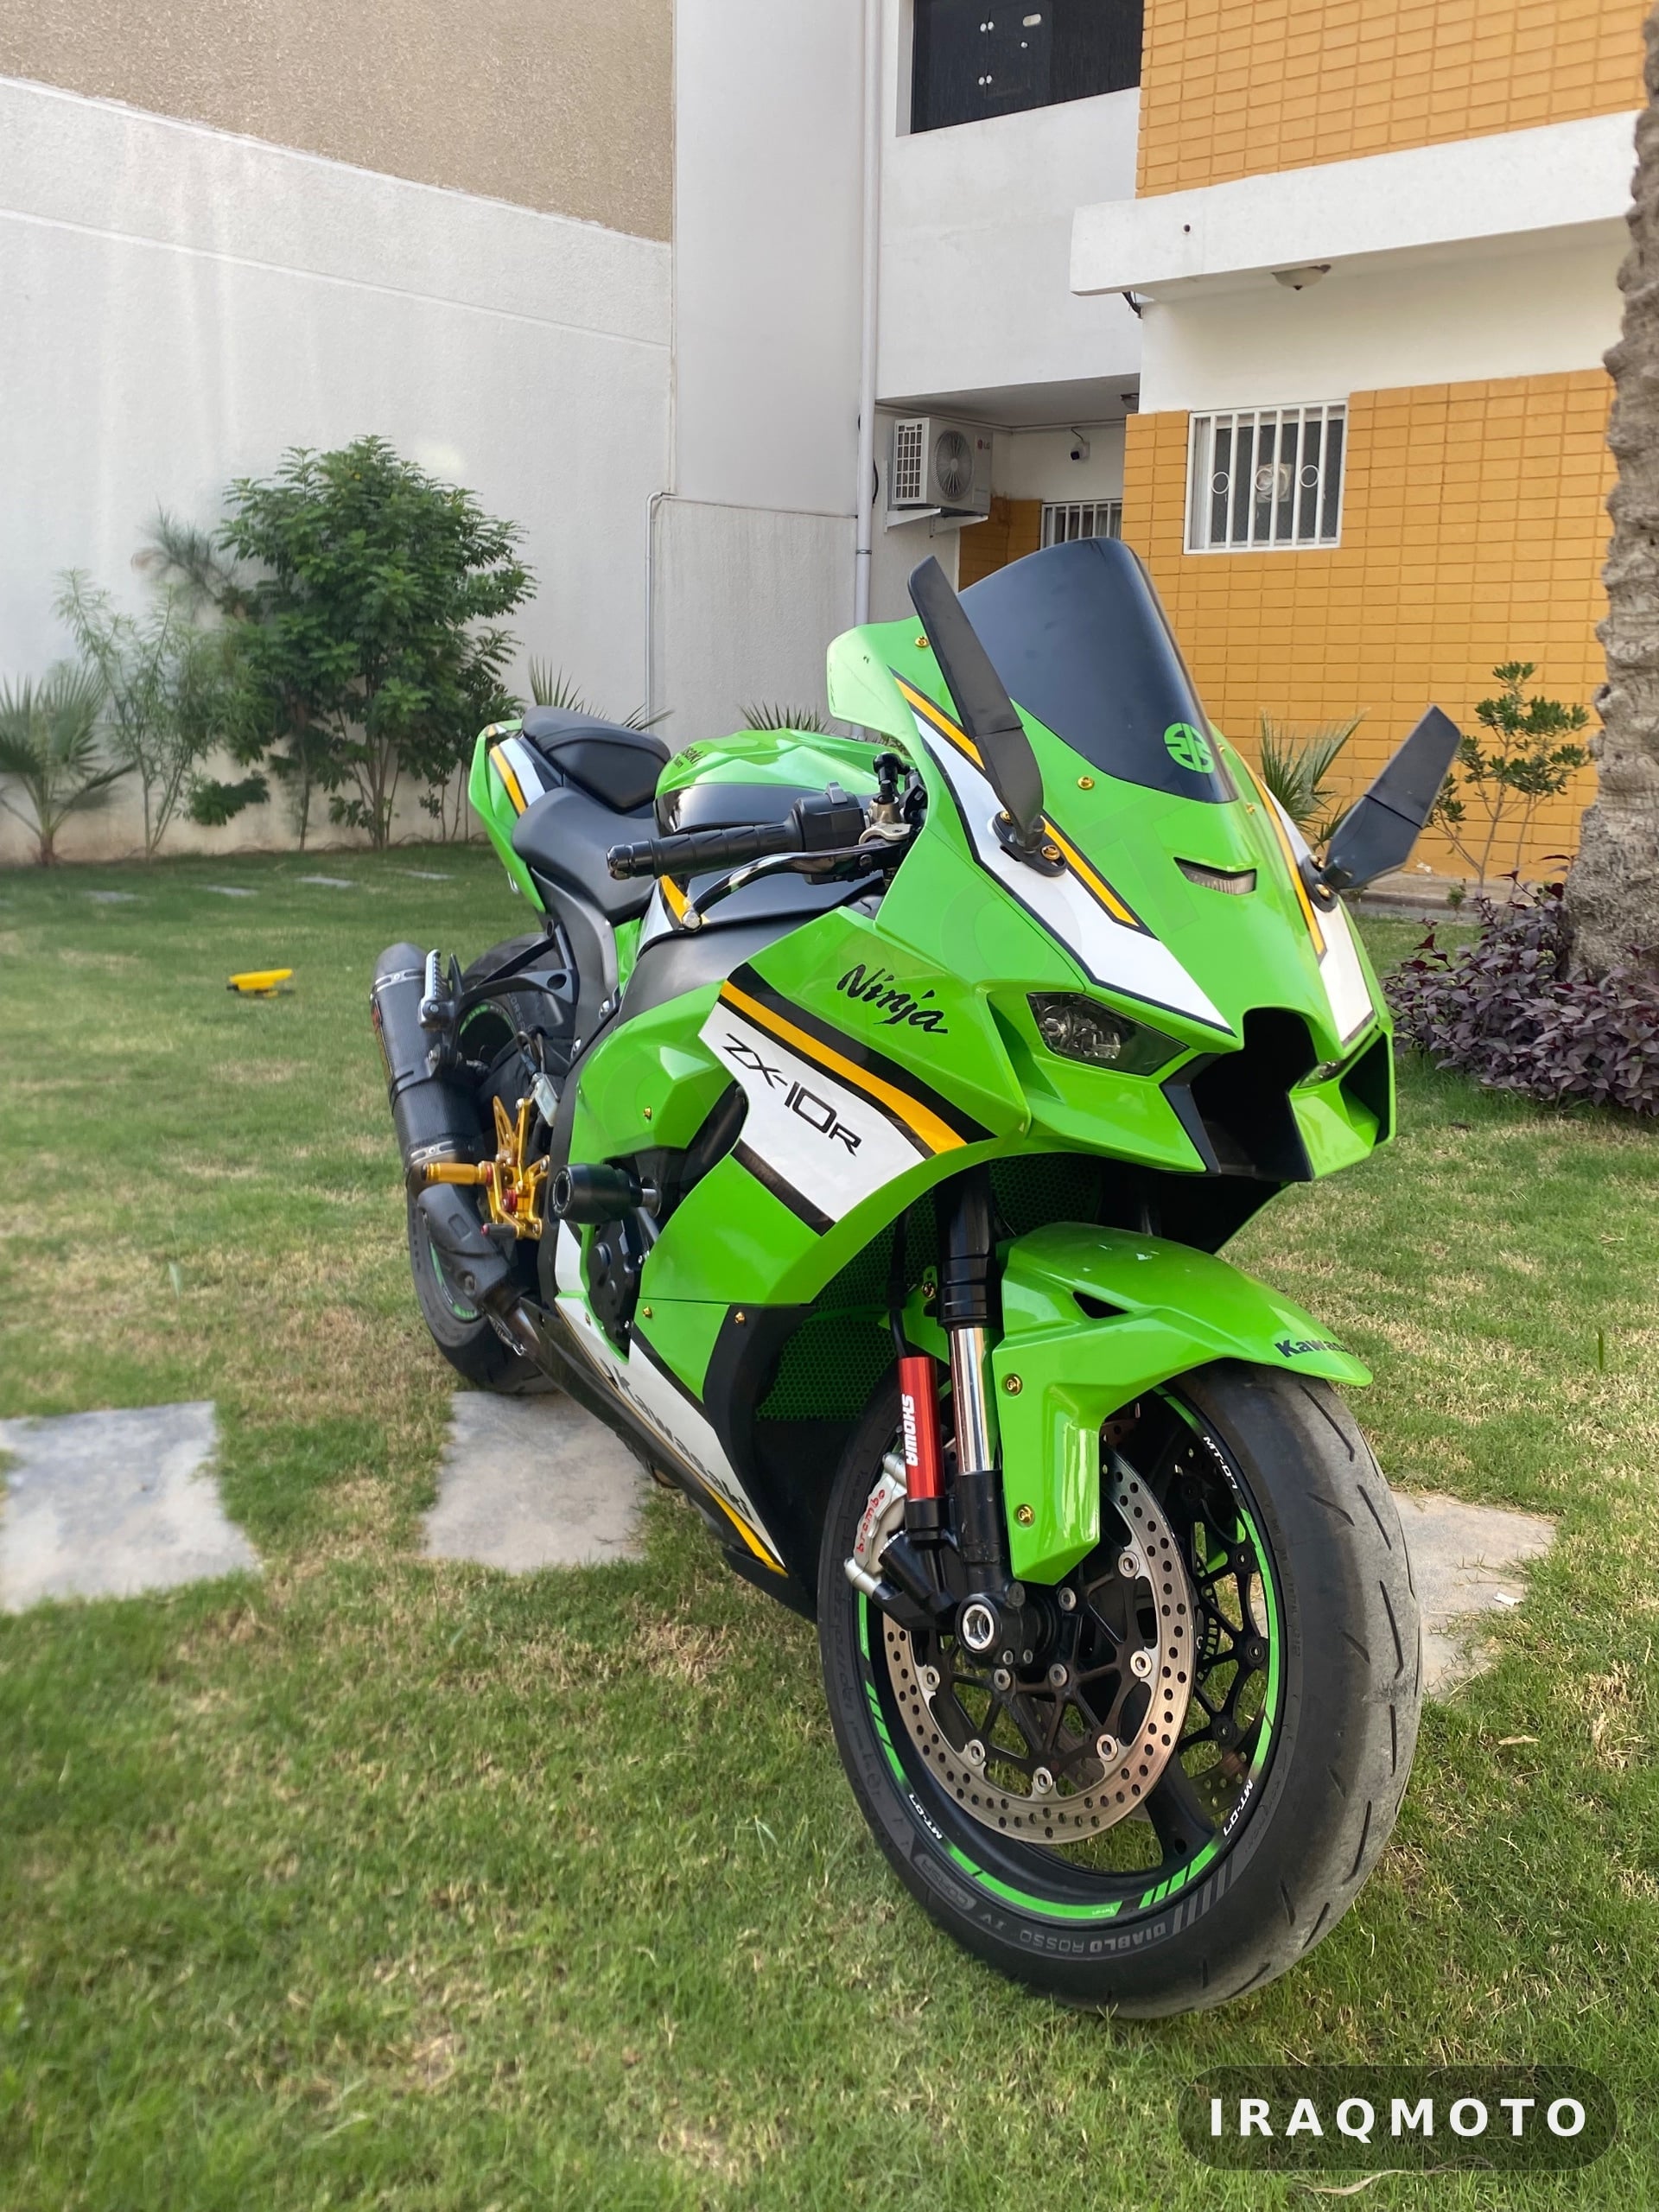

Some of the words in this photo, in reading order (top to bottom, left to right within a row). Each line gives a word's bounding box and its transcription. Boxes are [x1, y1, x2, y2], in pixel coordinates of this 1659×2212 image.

[836, 963, 949, 1034] Ninja
[721, 1033, 862, 1157] ZX-10R
[901, 1393, 918, 1466] SHOWA
[1203, 1436, 1238, 1489] MT-07
[856, 1489, 886, 1553] brembo
[908, 1794, 943, 1840] MT-07
[1223, 1778, 1254, 1836] MT-07
[1020, 1929, 1084, 1953] ROSSO
[1090, 1922, 1166, 1953] DIABLO
